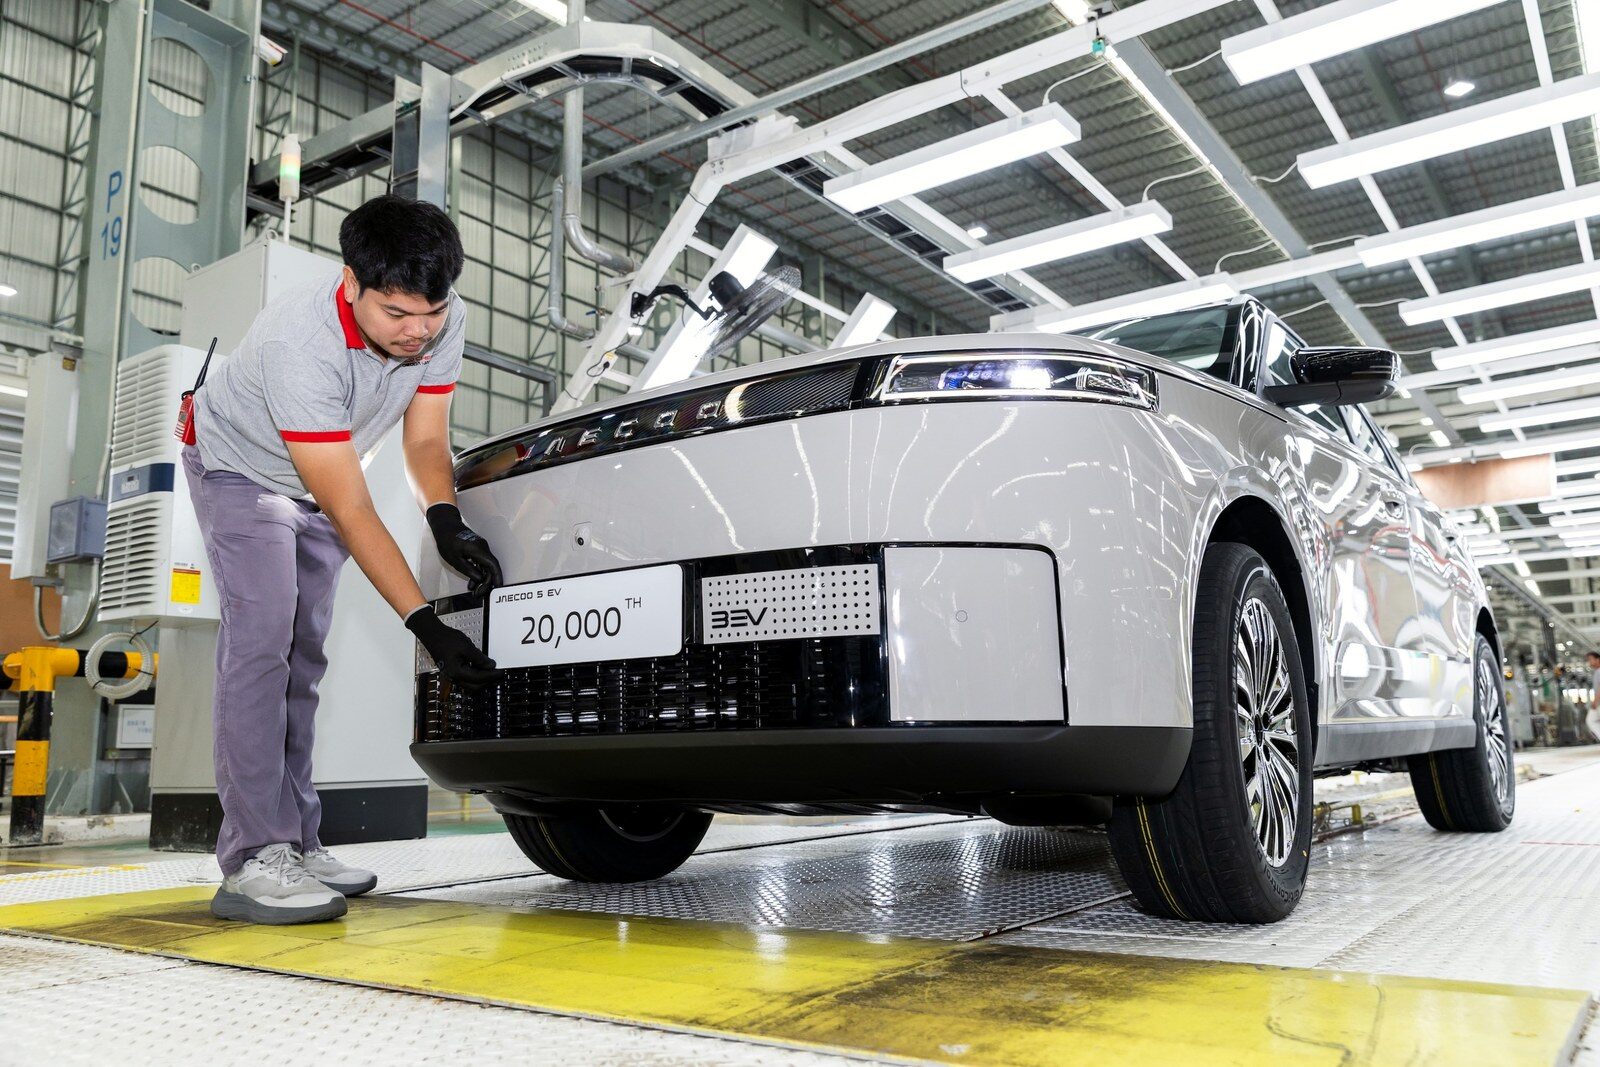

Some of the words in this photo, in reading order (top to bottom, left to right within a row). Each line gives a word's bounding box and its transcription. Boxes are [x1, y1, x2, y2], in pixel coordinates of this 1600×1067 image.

[107, 170, 122, 213] P
[101, 216, 122, 261] 19
[515, 400, 722, 461] JAECOO
[495, 591, 534, 604] JAECOO
[536, 590, 544, 599] 5
[547, 588, 562, 597] EV
[711, 606, 768, 629] BEV
[521, 606, 622, 649] 20,000
[624, 596, 642, 609] TH
